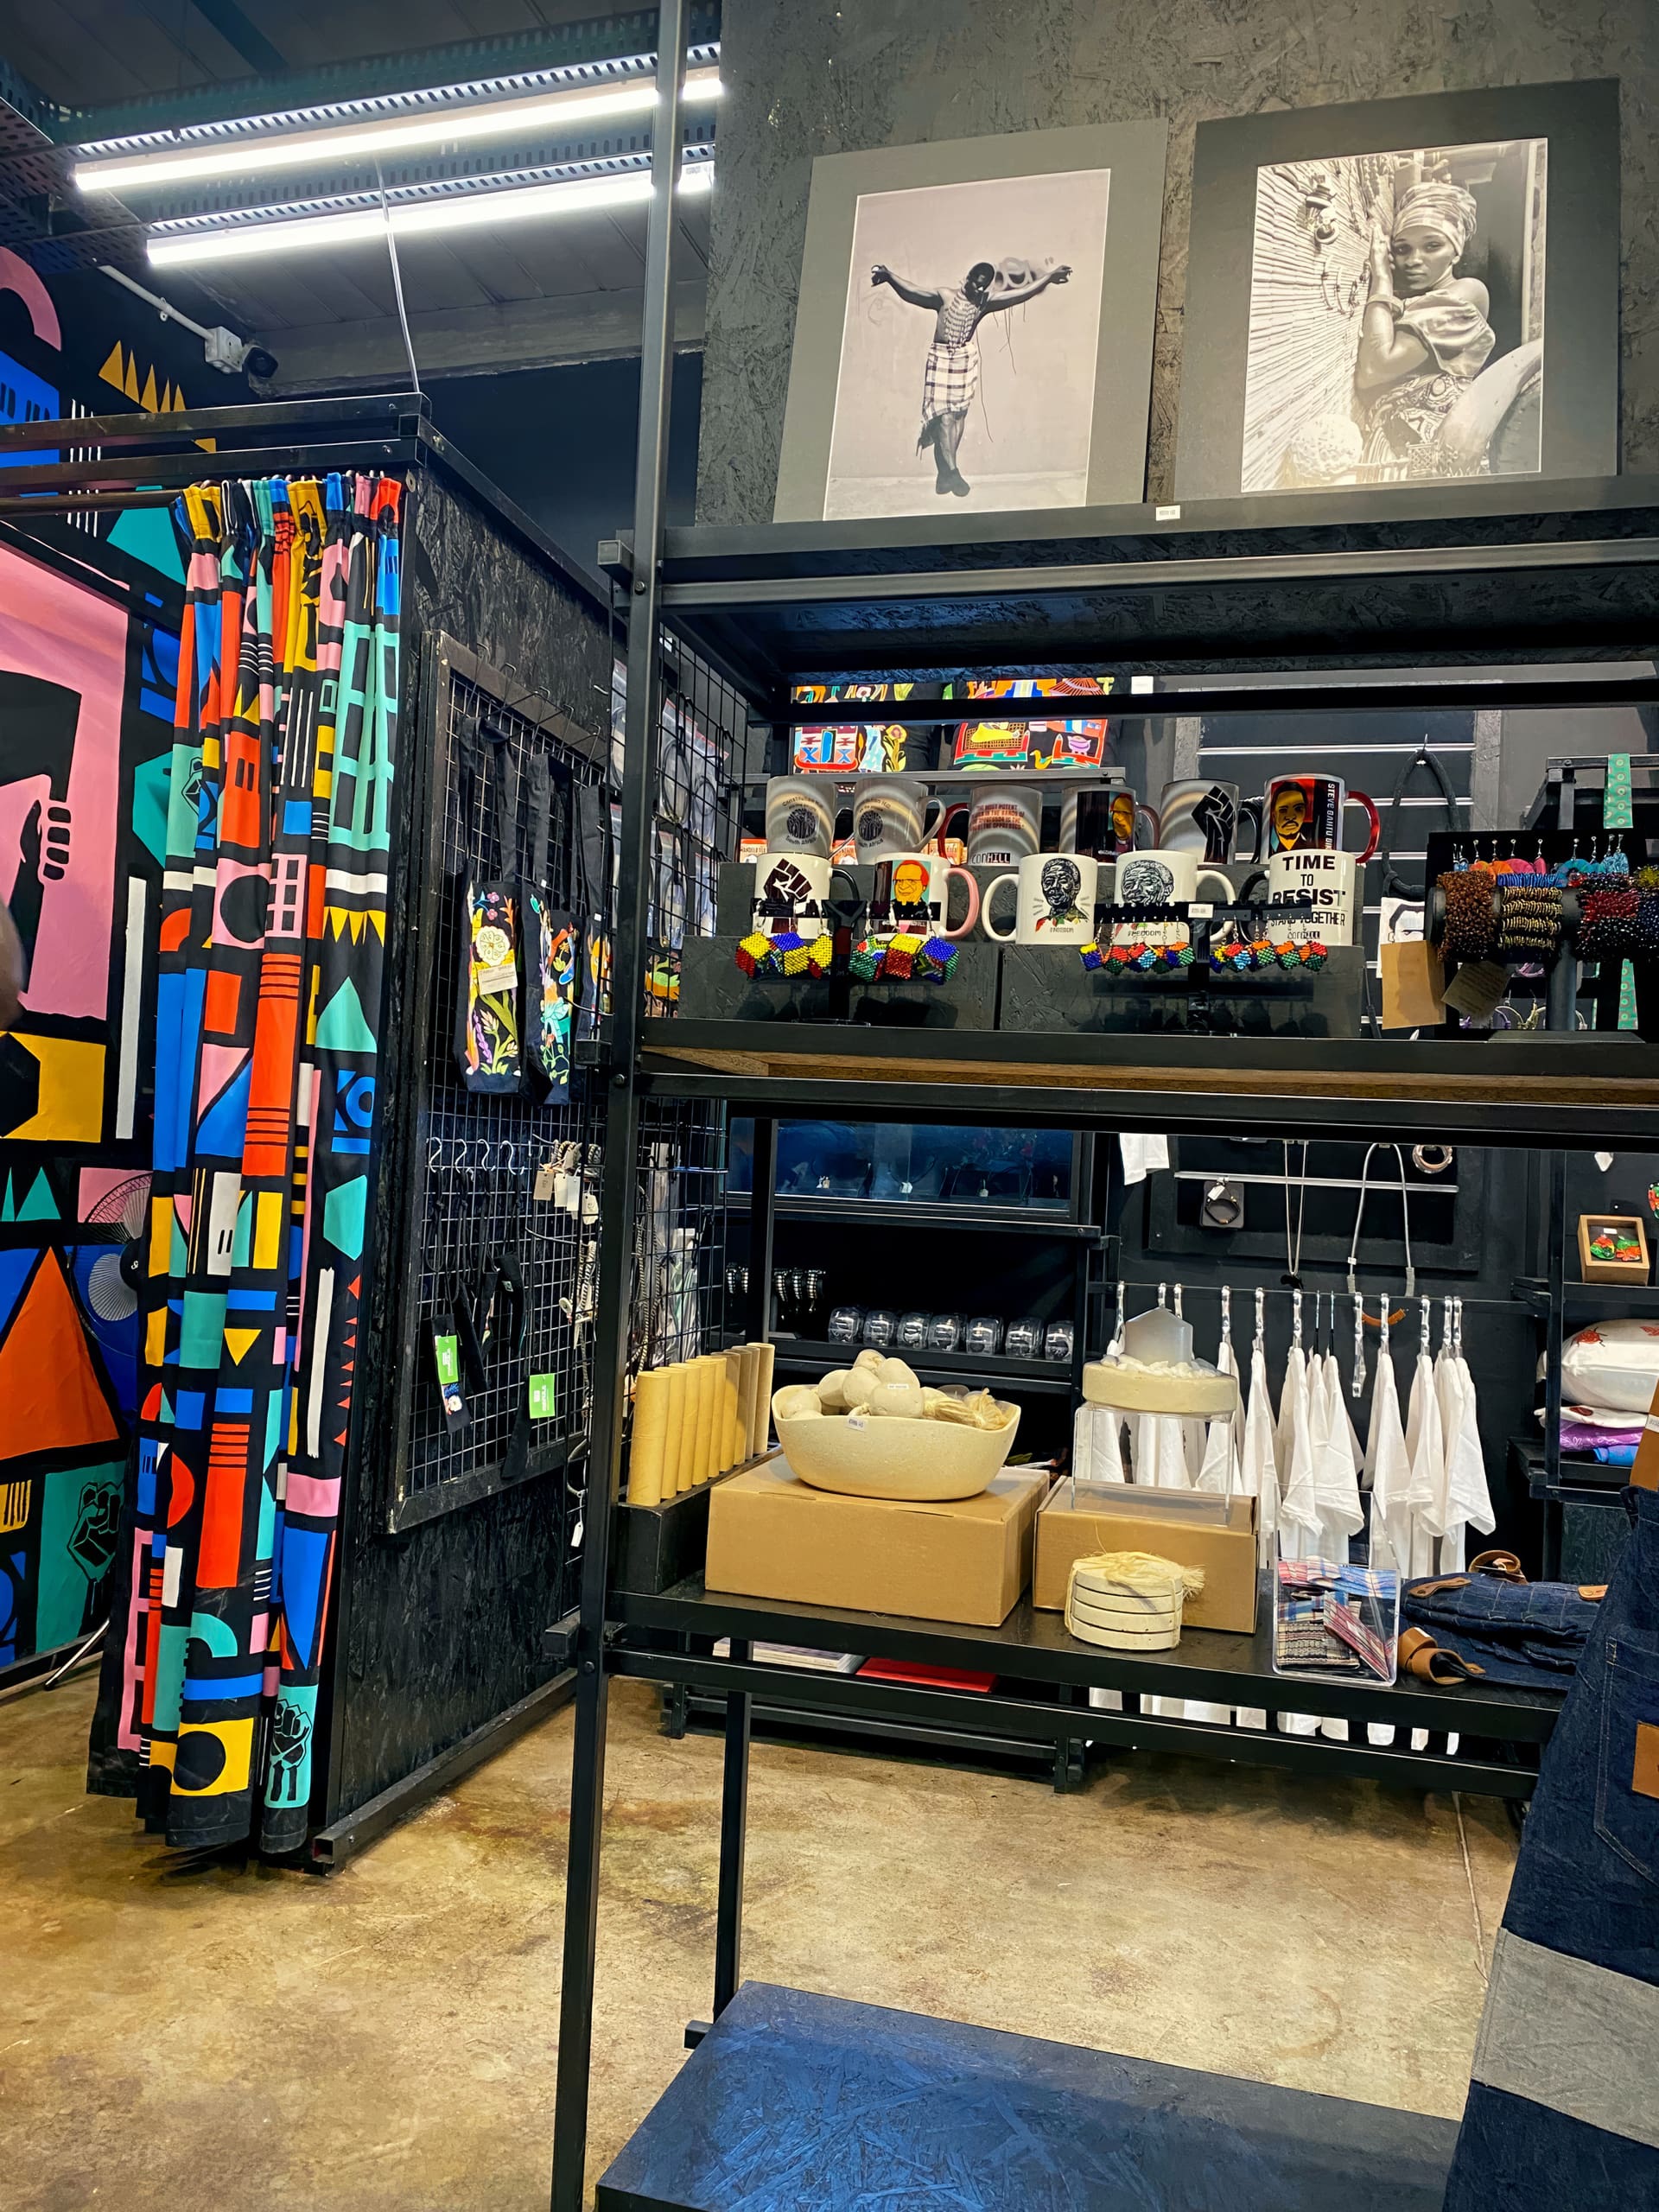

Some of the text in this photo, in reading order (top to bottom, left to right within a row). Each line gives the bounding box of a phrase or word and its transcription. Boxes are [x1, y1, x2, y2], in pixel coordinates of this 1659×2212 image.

[1325, 837, 1333, 850] BIK
[1282, 855, 1336, 871] TIME
[1300, 874, 1314, 887] TO
[1272, 888, 1346, 906] RESIST
